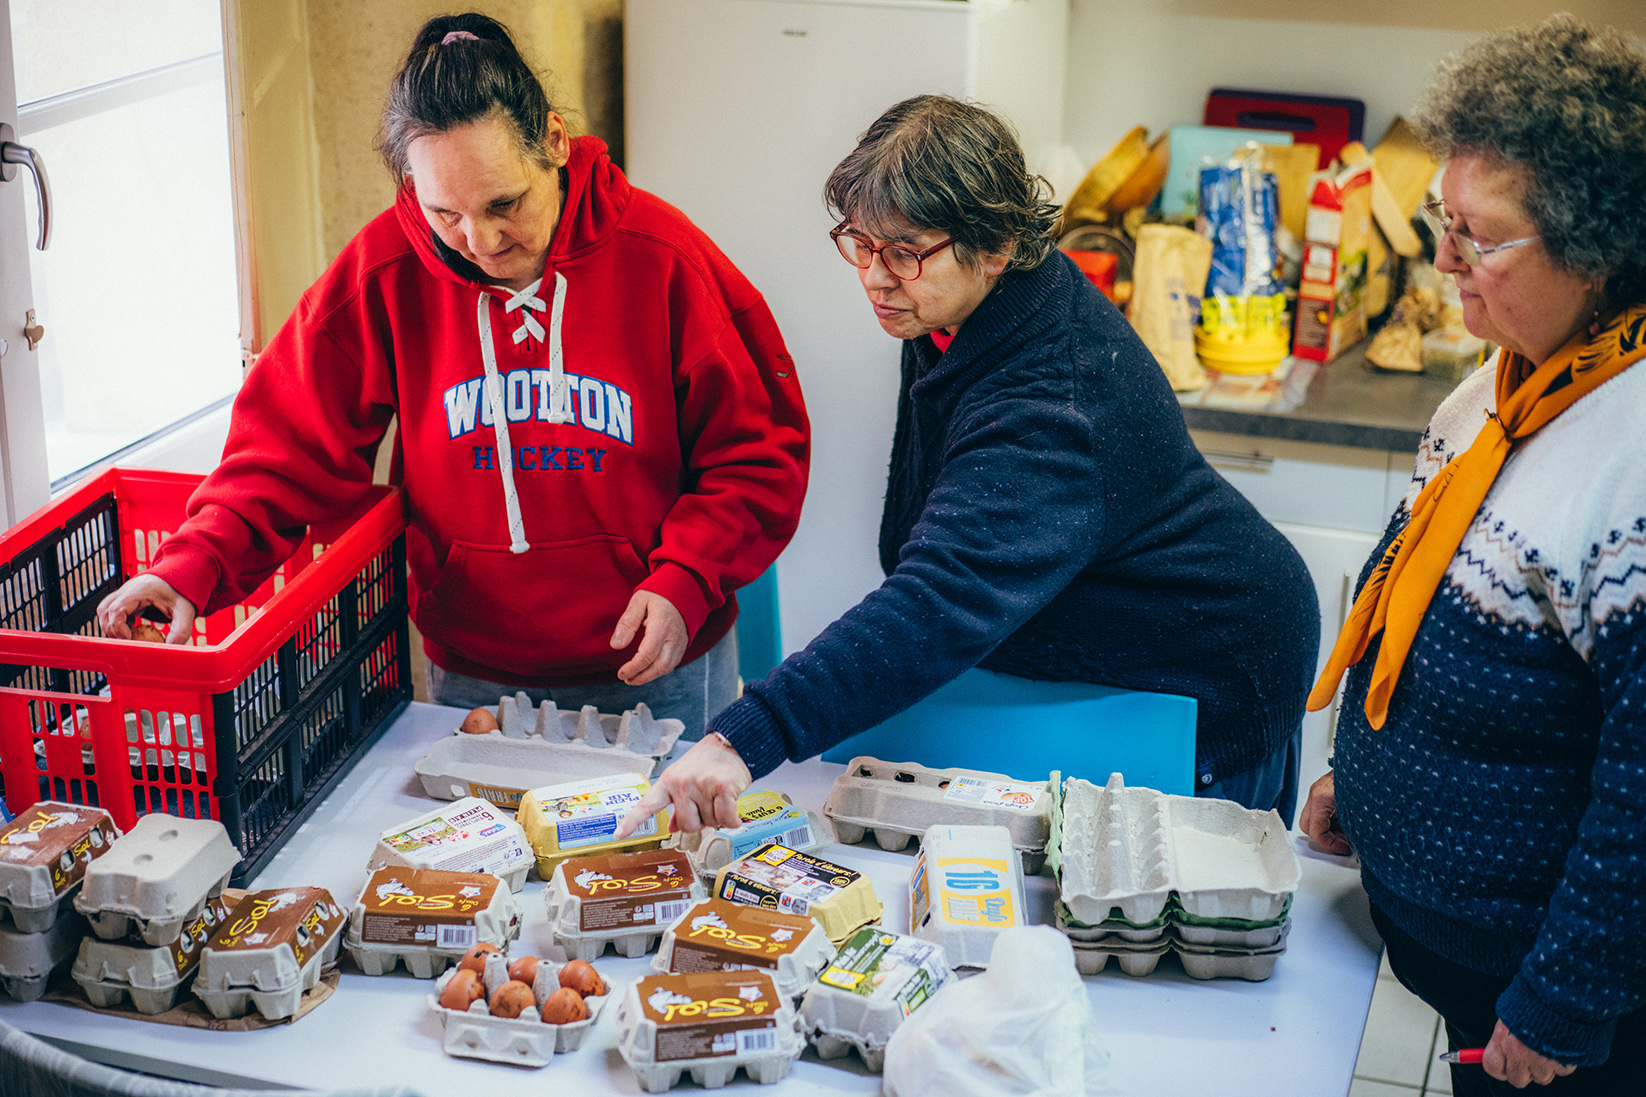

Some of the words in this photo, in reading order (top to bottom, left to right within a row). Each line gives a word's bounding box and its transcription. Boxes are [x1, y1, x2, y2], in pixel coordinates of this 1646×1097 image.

[473, 446, 607, 471] HCKEY
[605, 796, 640, 806] PLEIN
[607, 792, 631, 800] AIR
[230, 899, 278, 936] Sol
